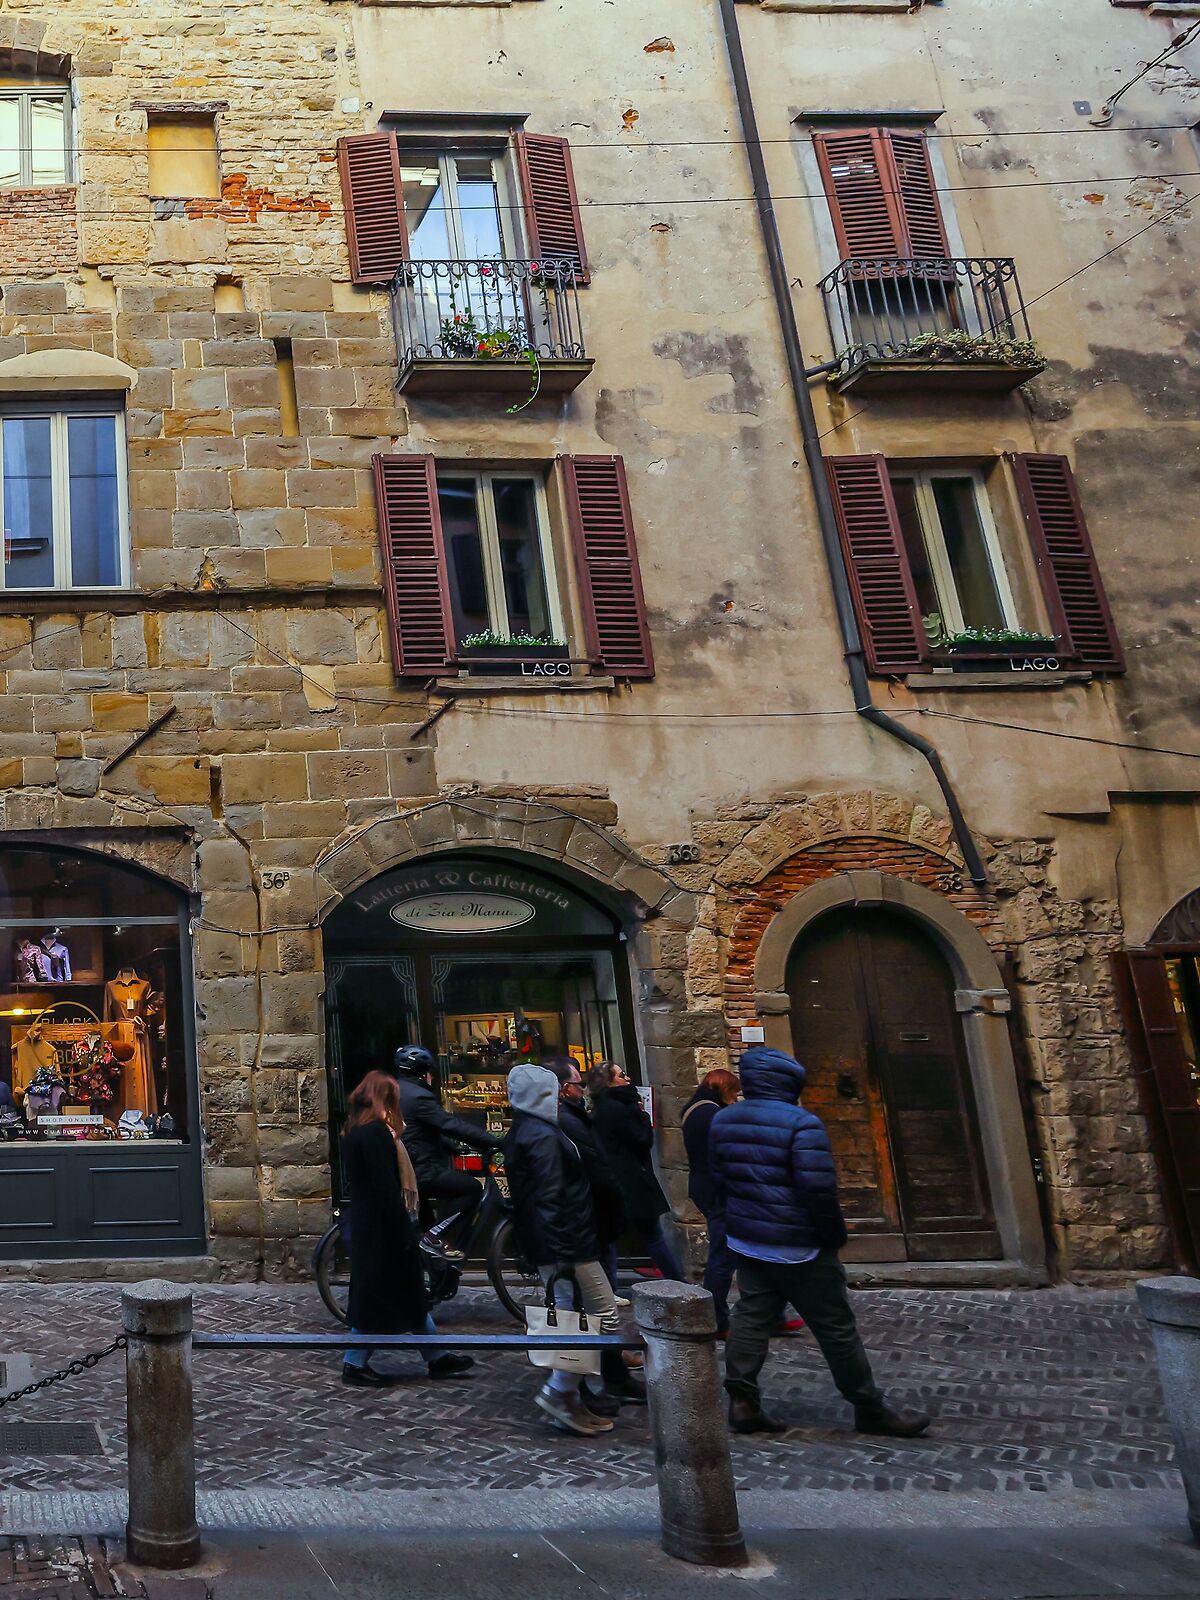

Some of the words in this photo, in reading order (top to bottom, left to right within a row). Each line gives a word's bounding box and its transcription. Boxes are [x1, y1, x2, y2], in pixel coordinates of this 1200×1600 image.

[521, 662, 570, 675] LAGO
[1010, 657, 1060, 671] LAGO
[354, 878, 431, 912] Latteria
[467, 870, 571, 910] Caffetteria
[405, 906, 421, 918] di
[427, 902, 455, 918] Zia
